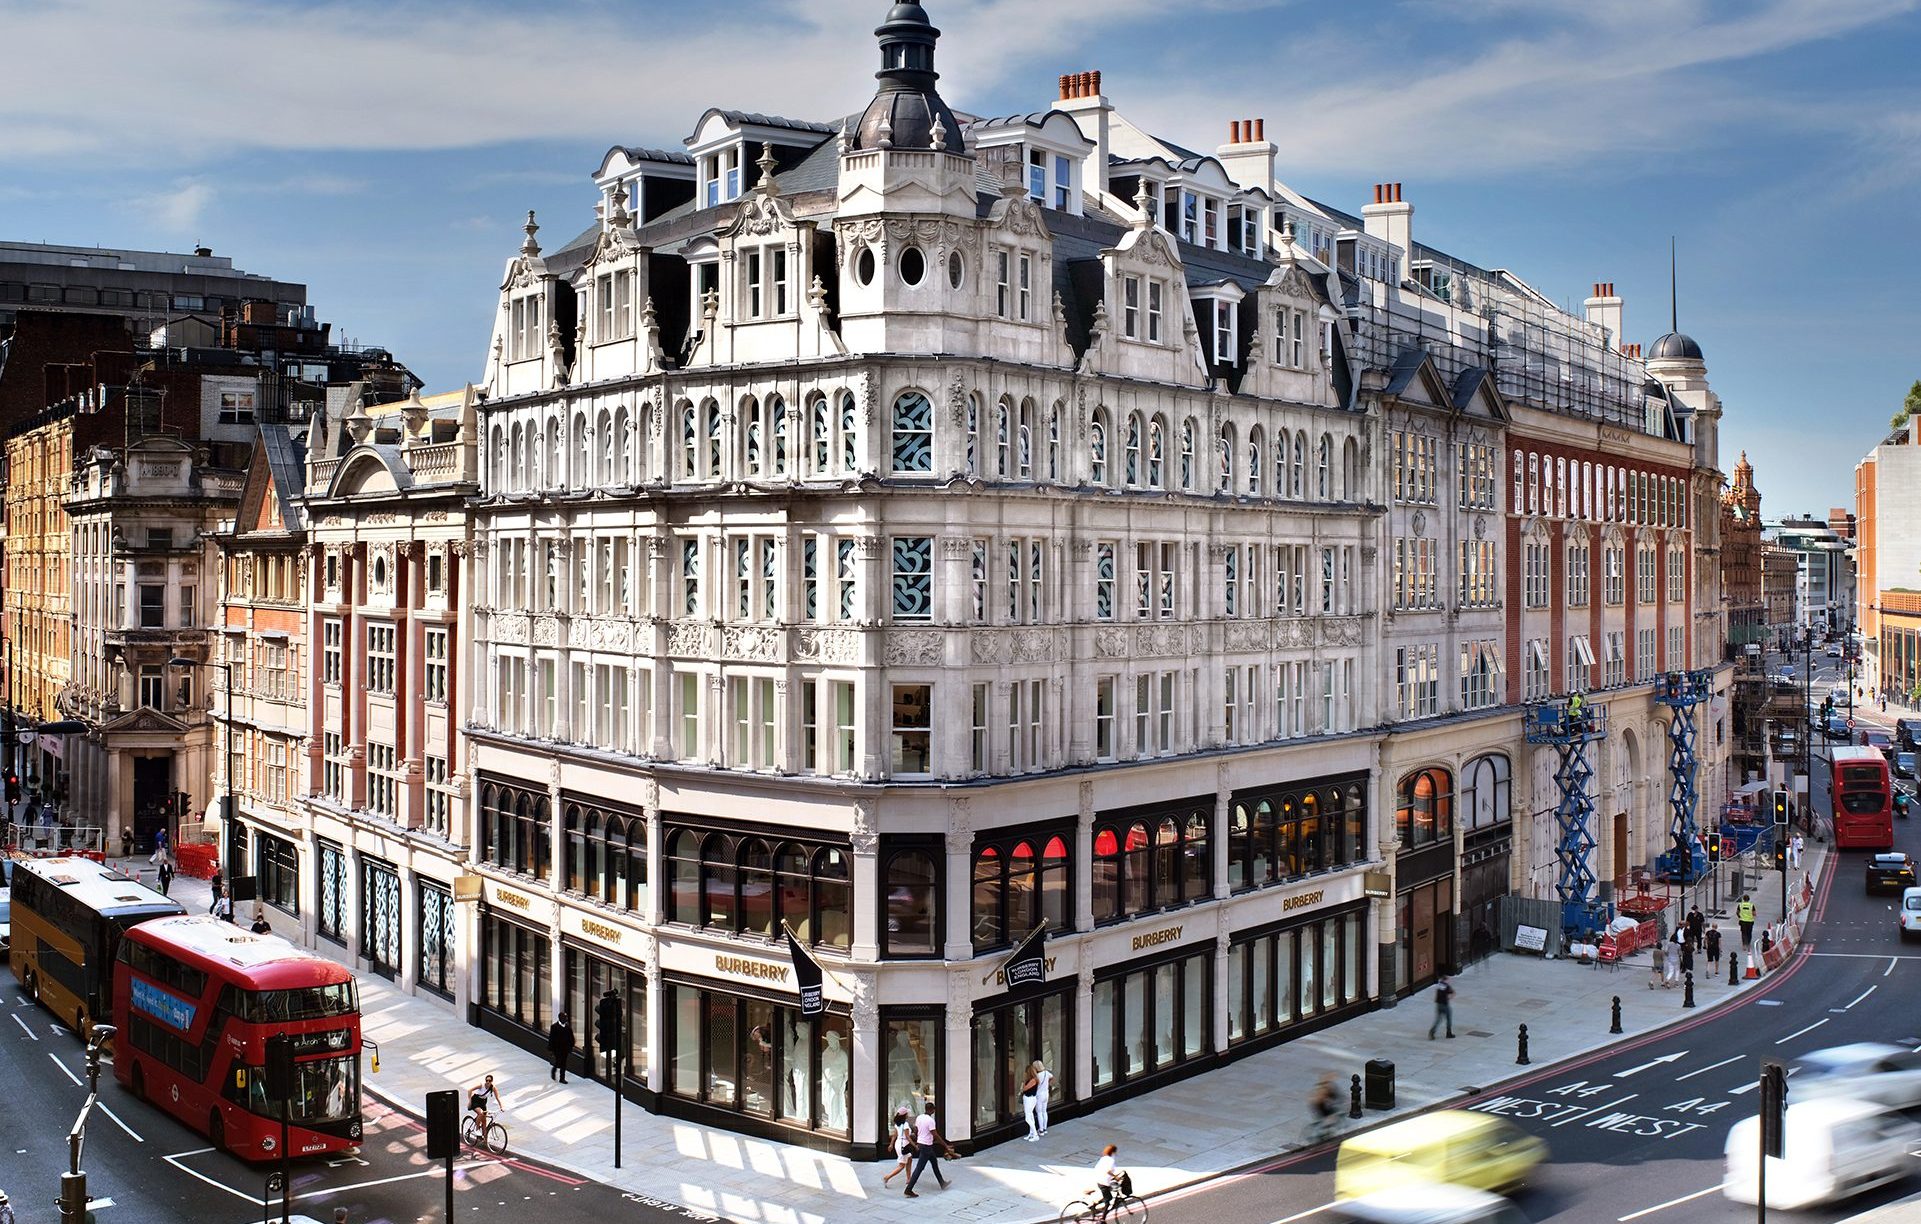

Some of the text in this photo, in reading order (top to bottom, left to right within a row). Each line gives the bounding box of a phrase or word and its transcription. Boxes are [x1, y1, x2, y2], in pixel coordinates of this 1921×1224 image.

[497, 888, 530, 910] BURBERRY
[1283, 890, 1324, 911] BURBERRY
[582, 919, 621, 944] BURBERRY
[1133, 925, 1183, 951] BURBERRY
[715, 956, 789, 983] BURBERRY
[1011, 962, 1039, 973] BURBERRY
[1014, 967, 1038, 976] LONDON
[1014, 971, 1040, 980] ENGLAND
[327, 1031, 345, 1046] 137
[1546, 1081, 1613, 1098] A4
[1468, 1096, 1587, 1120] WEST
[1663, 1097, 1731, 1115] A4
[1585, 1112, 1707, 1138] WEST
